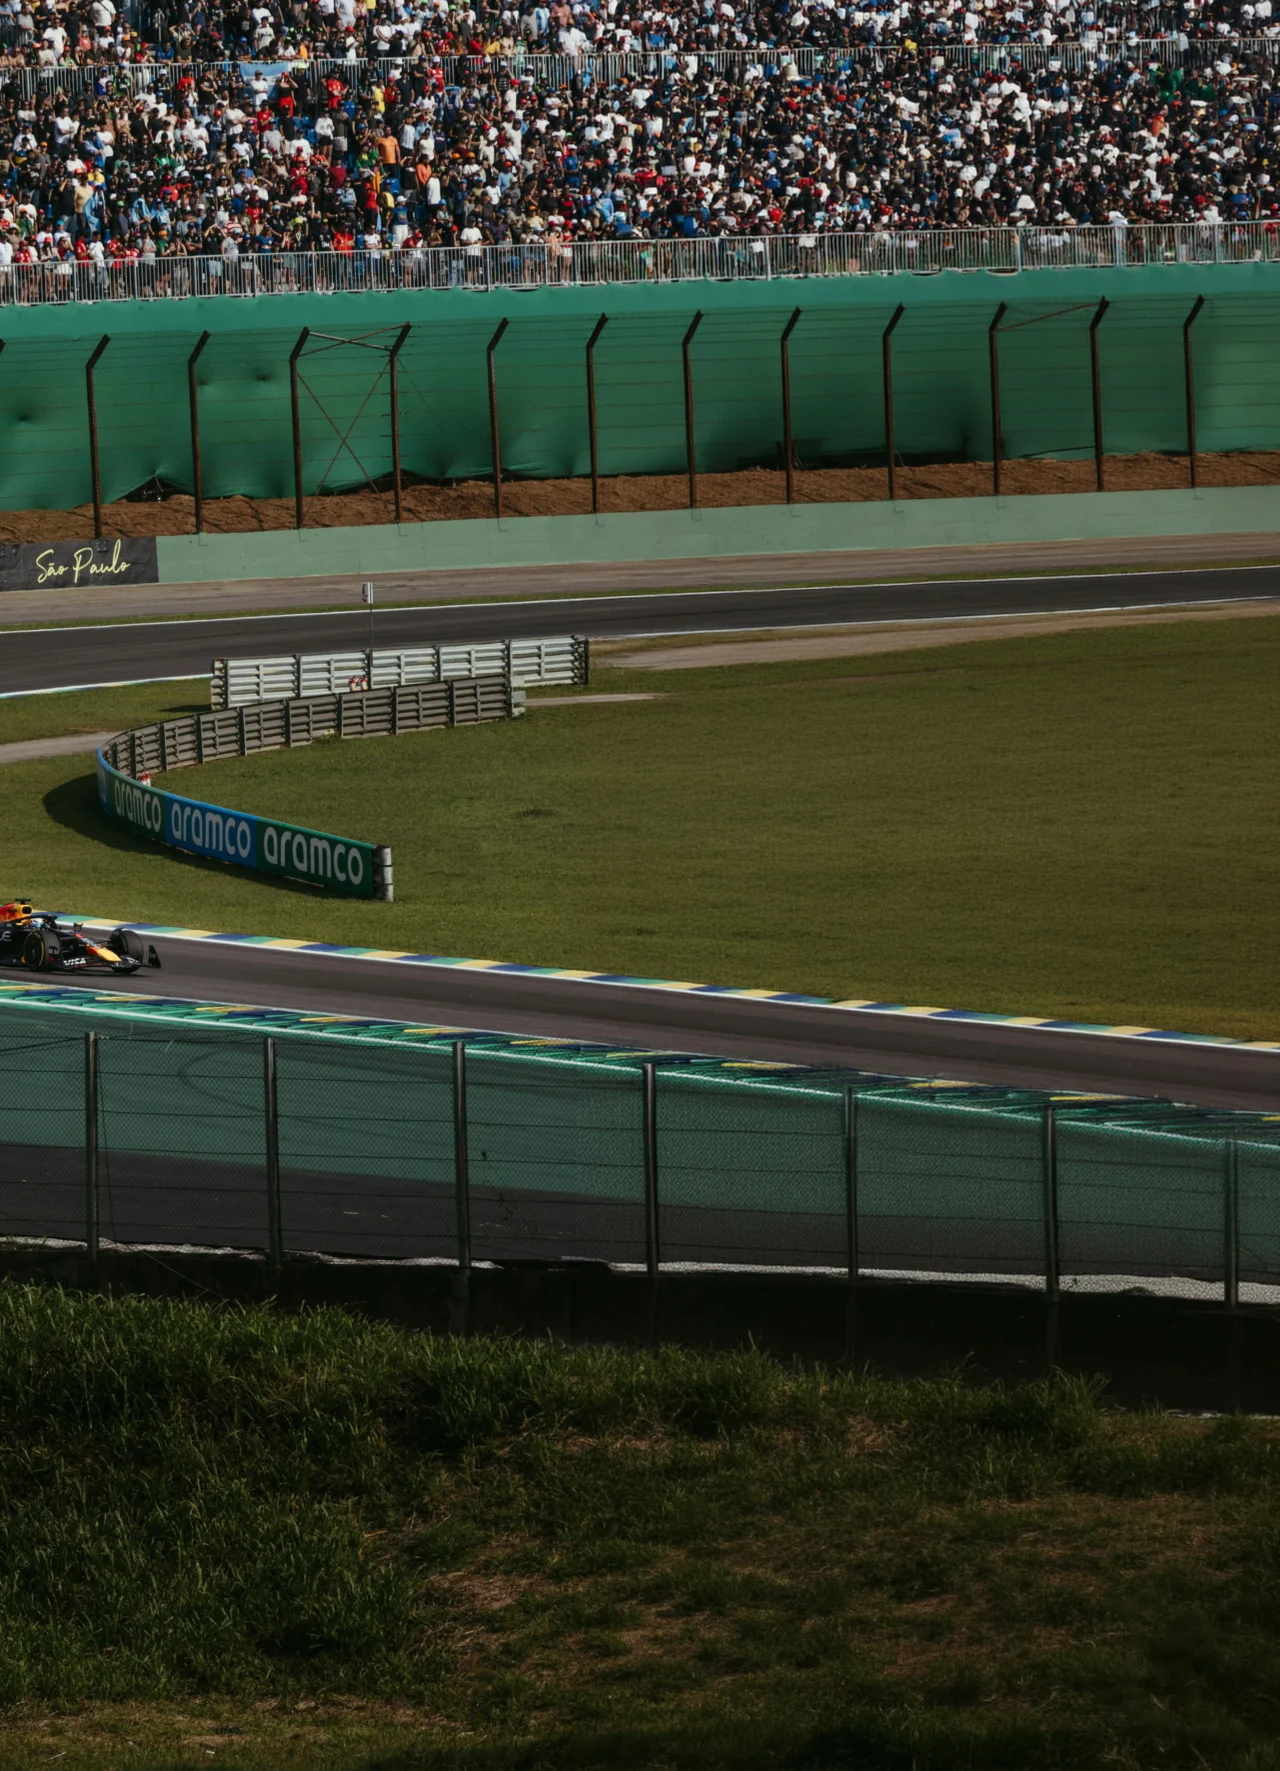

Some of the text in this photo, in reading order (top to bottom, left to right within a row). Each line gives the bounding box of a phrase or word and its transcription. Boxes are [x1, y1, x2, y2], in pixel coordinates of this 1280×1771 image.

[36, 539, 131, 583] São Paulo
[114, 779, 162, 833] aramco
[171, 801, 251, 859] aramco
[263, 826, 364, 886] aramco
